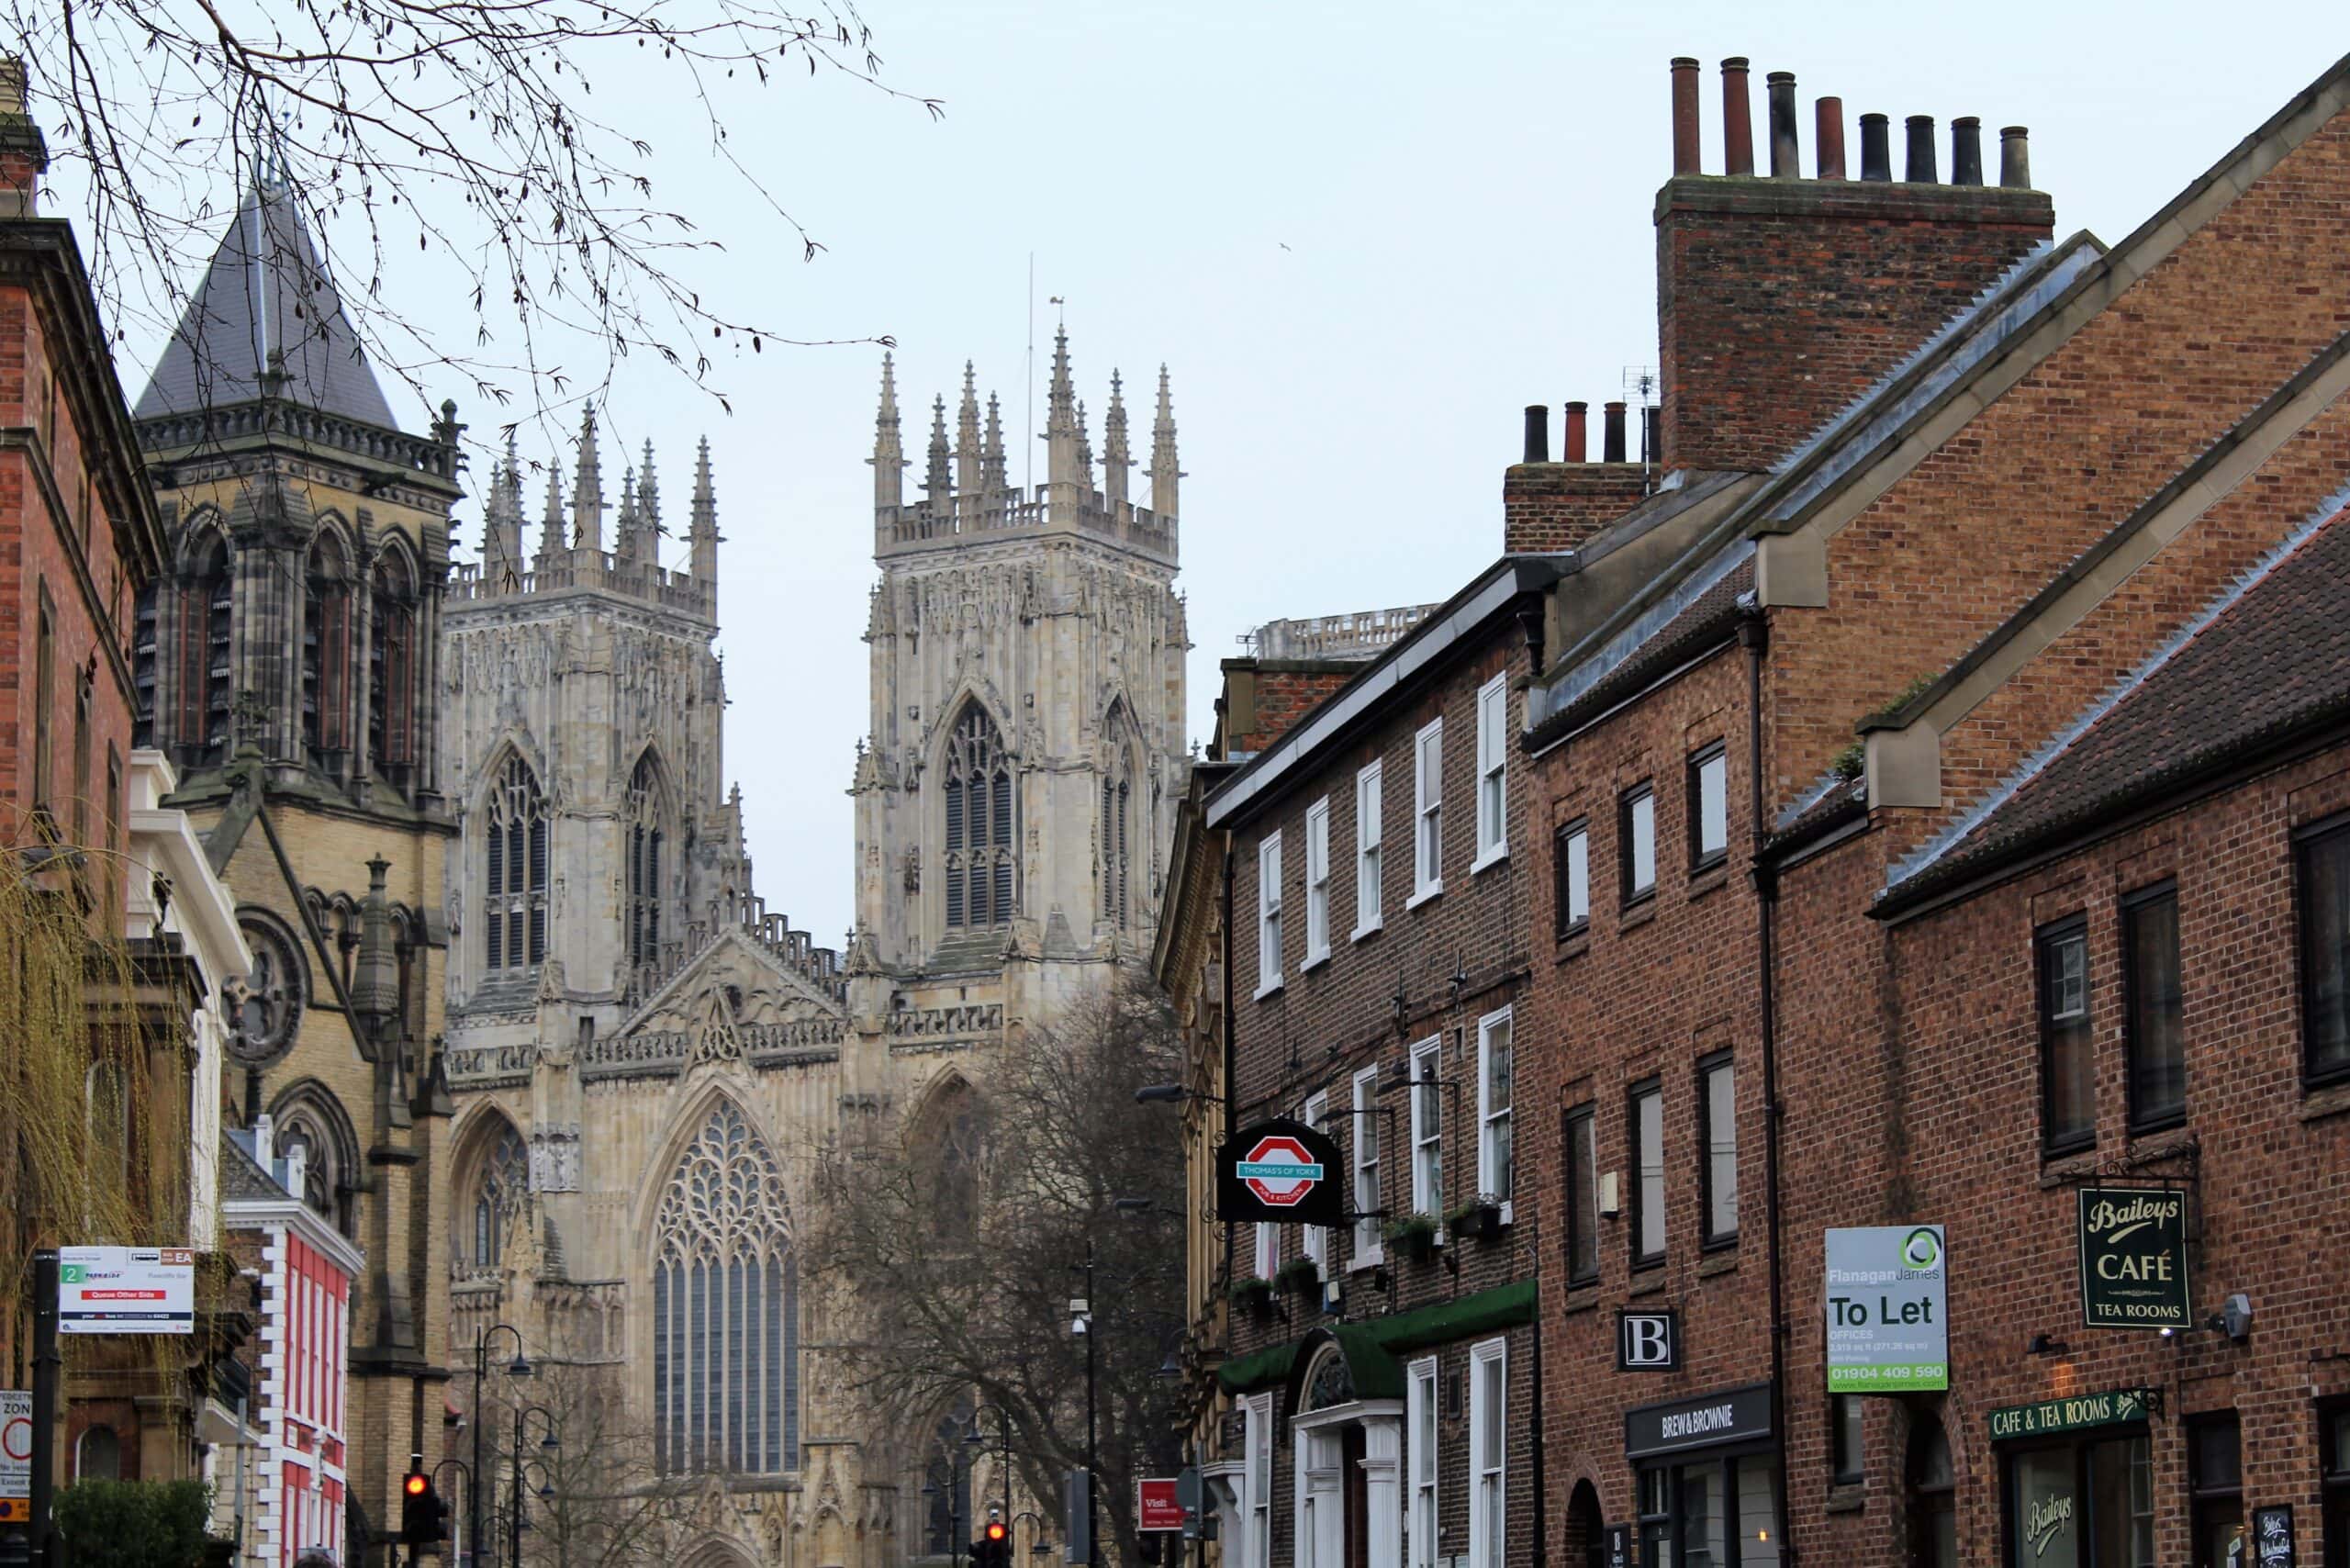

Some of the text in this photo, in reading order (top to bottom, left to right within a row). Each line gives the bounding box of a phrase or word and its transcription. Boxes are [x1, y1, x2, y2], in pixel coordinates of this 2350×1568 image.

[1283, 1167, 1294, 1175] OF
[1295, 1168, 1315, 1176] YORK
[2087, 1197, 2178, 1233] Baileys
[175, 1252, 192, 1262] EA
[2098, 1249, 2172, 1281] CAFÉ
[66, 1268, 76, 1282] 2
[1829, 1296, 1931, 1326] To Let
[2096, 1304, 2181, 1317] TEA ROOMS
[1628, 1318, 1667, 1362] B
[1830, 1329, 1874, 1339] OFFICES
[1832, 1366, 1943, 1379] 01904 409 590
[3, 1404, 30, 1414] ZON
[1993, 1396, 2110, 1434] CAFE & TEA ROOMS
[1145, 1498, 1168, 1507] Visit
[2027, 1493, 2071, 1542] Baileys
